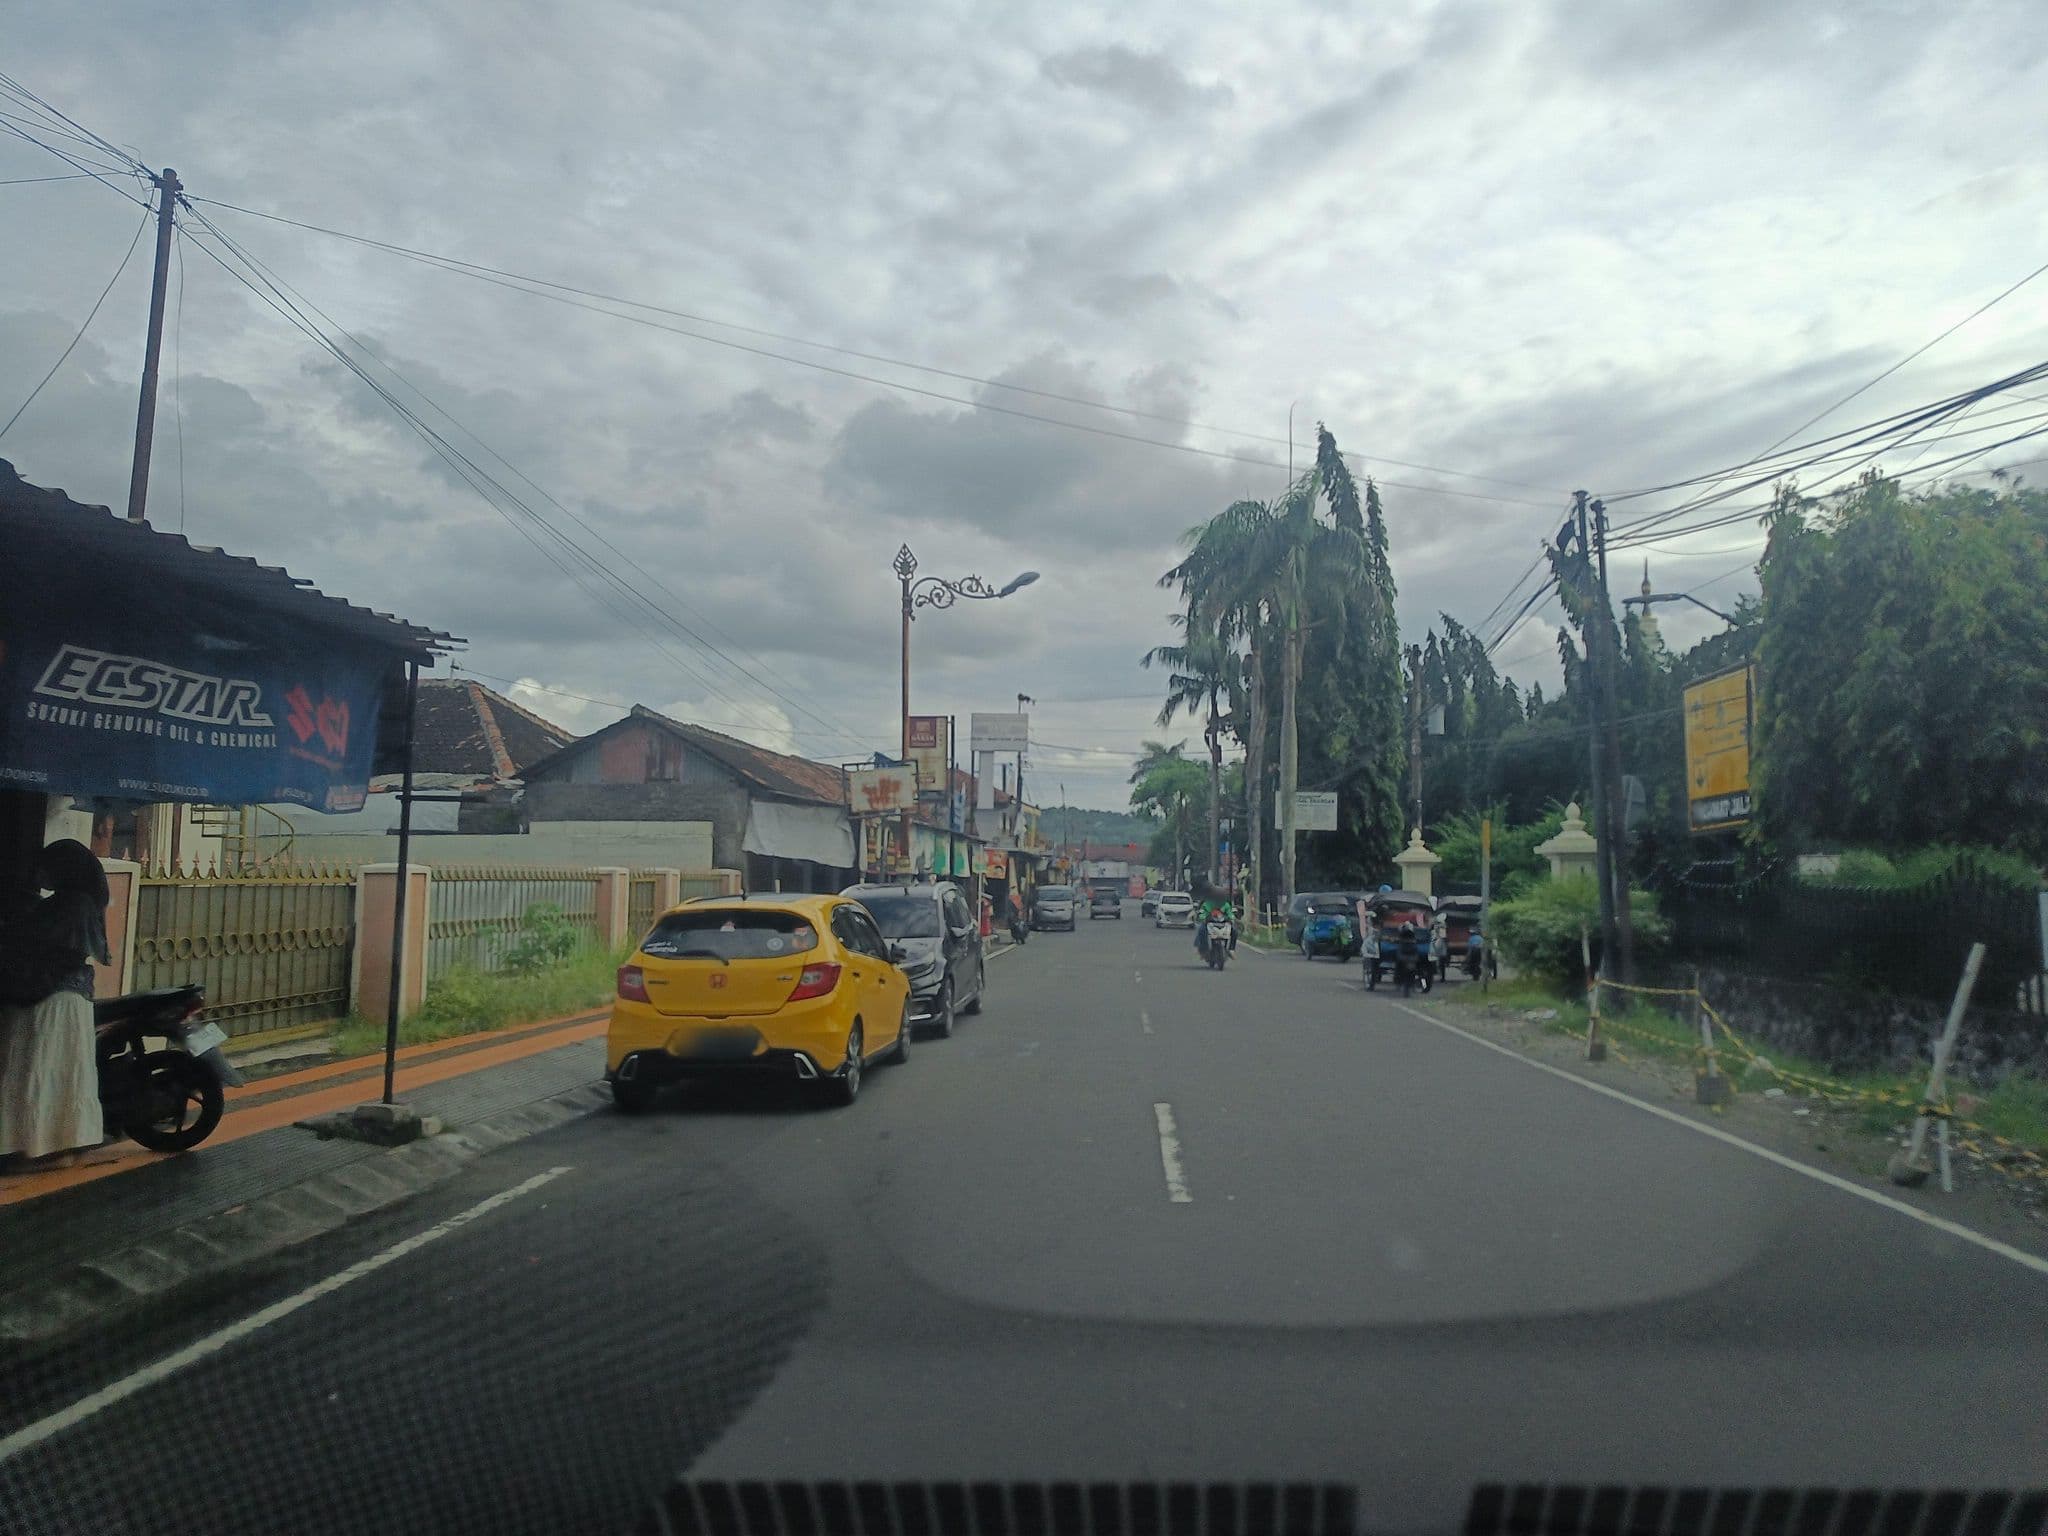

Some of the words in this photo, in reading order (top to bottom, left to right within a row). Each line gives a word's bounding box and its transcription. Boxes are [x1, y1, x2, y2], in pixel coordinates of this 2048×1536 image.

[33, 643, 276, 727] ECSTAR
[27, 702, 88, 727] SUZUKI
[94, 713, 163, 737] GENUINE
[170, 725, 190, 743] OIL
[196, 732, 204, 745] &
[211, 731, 278, 749] CHEMICAL
